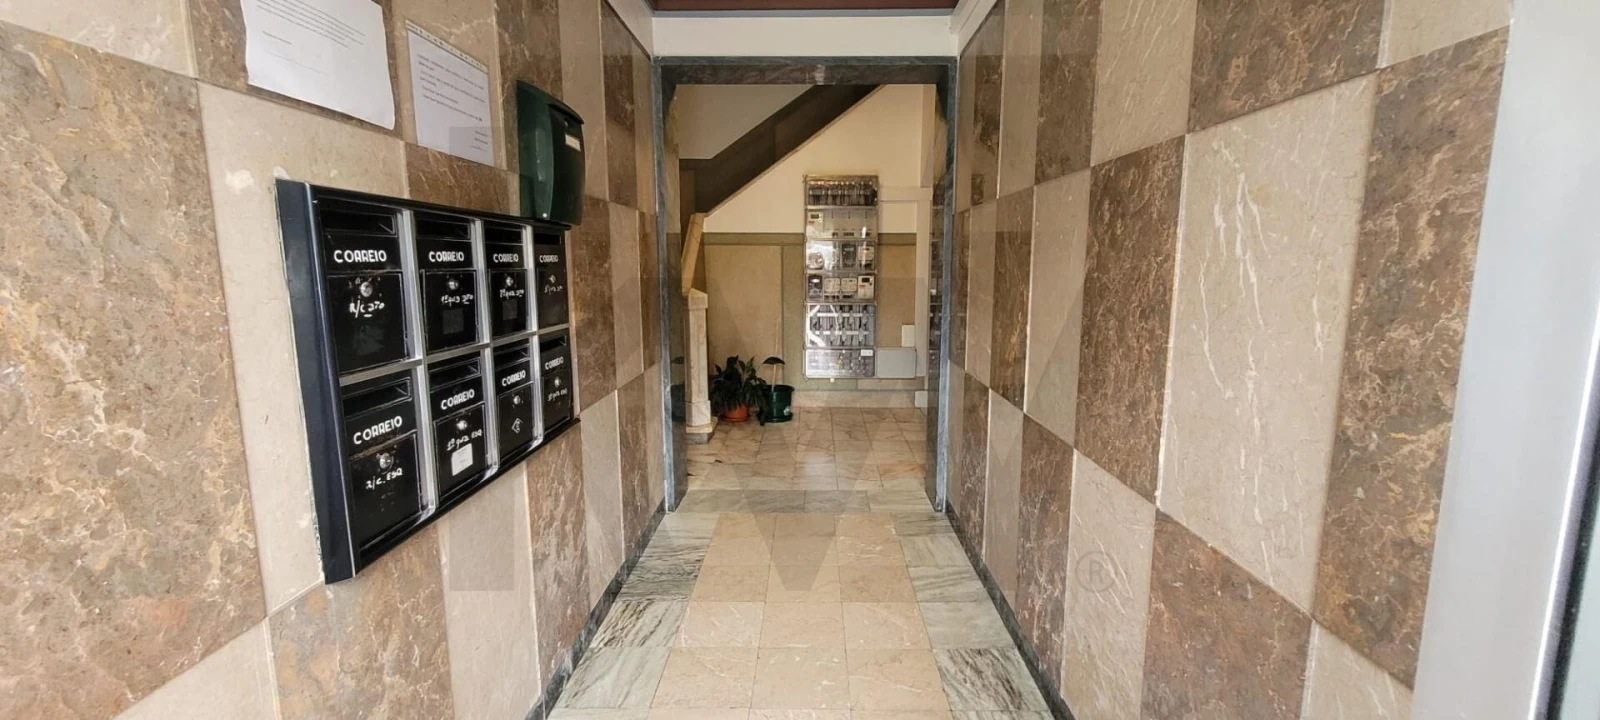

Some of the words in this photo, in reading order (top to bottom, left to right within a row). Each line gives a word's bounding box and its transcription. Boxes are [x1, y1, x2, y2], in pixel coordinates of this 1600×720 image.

[334, 250, 387, 263] CORREIO
[429, 251, 465, 263] CORREIO
[493, 253, 519, 263] CORREIO
[501, 370, 527, 387] CORREIO
[440, 388, 475, 410] CORREIO
[353, 415, 403, 445] CORREIO
